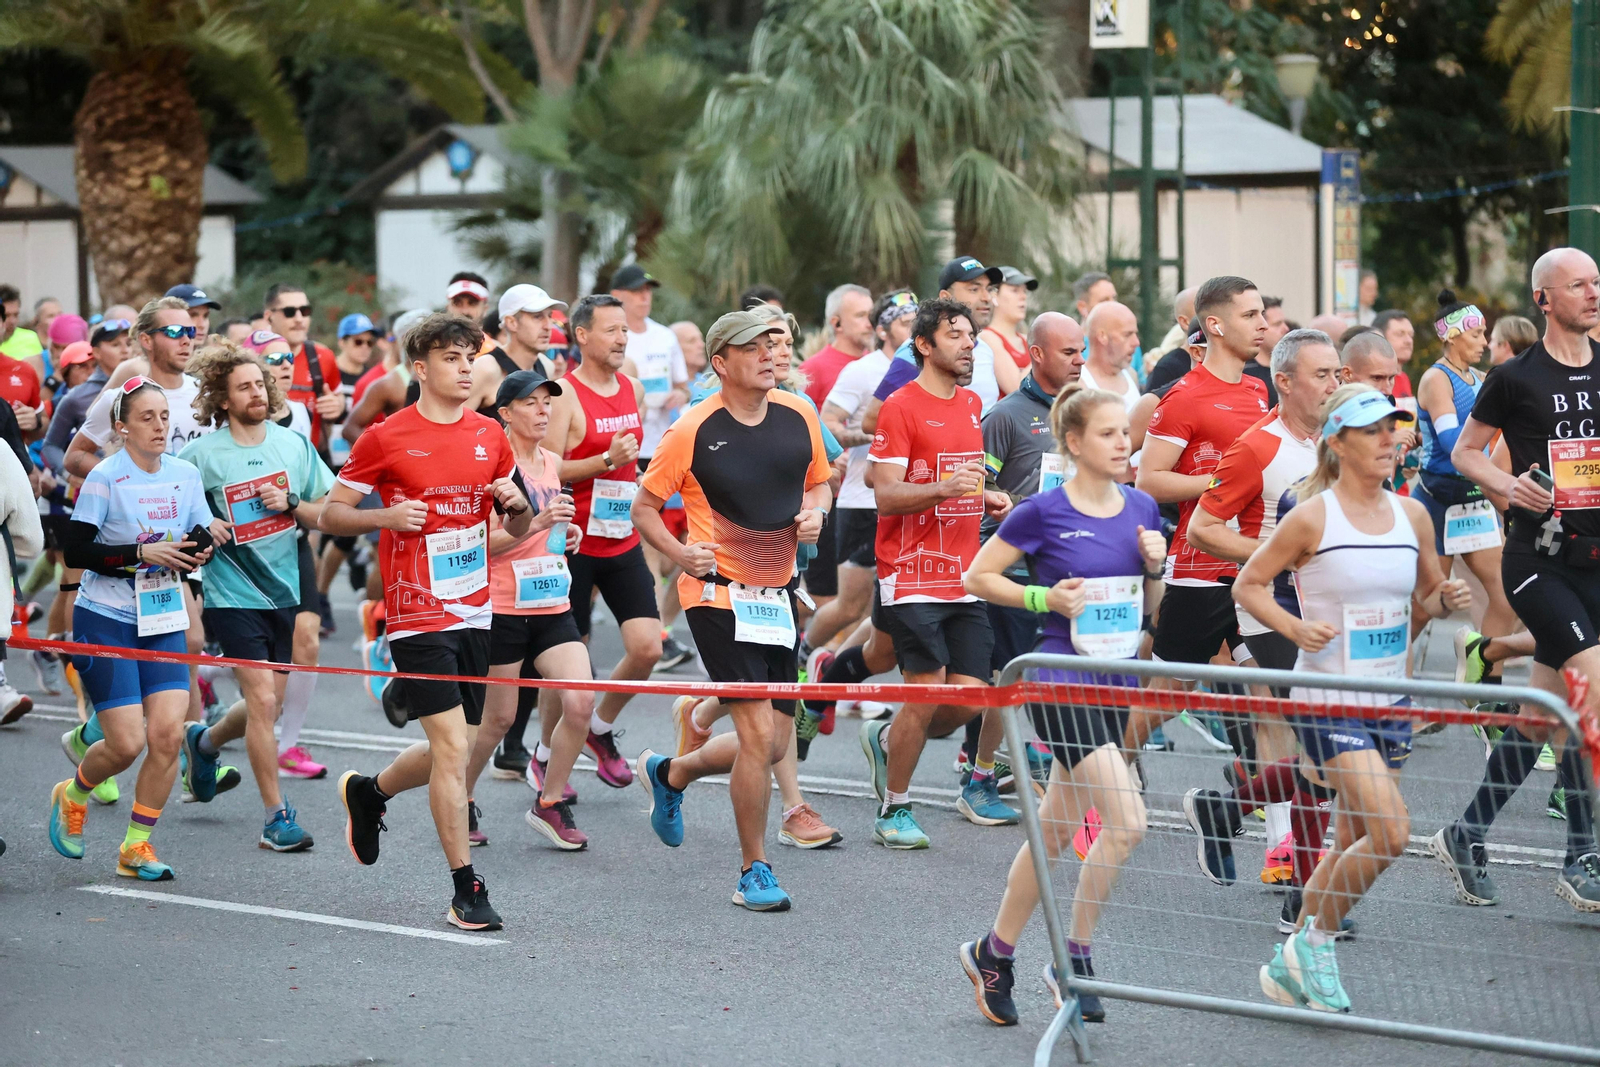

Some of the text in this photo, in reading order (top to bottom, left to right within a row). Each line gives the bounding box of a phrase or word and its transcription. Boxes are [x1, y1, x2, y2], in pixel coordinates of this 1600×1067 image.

[1568, 375, 1587, 383] CRAFT
[594, 412, 641, 434] DENMARK
[247, 458, 264, 466] vive
[1573, 464, 1600, 476] 2295
[434, 485, 471, 495] GENERALI
[435, 501, 472, 515] MÁLAGA
[147, 509, 173, 520] MÁLAGA
[448, 550, 478, 568] 11982
[532, 578, 560, 590] 12612
[151, 593, 172, 605] 11835
[747, 605, 779, 618] 11837
[1095, 607, 1128, 621] 12742
[1570, 621, 1586, 641] FUSION
[1368, 630, 1402, 646] 11729
